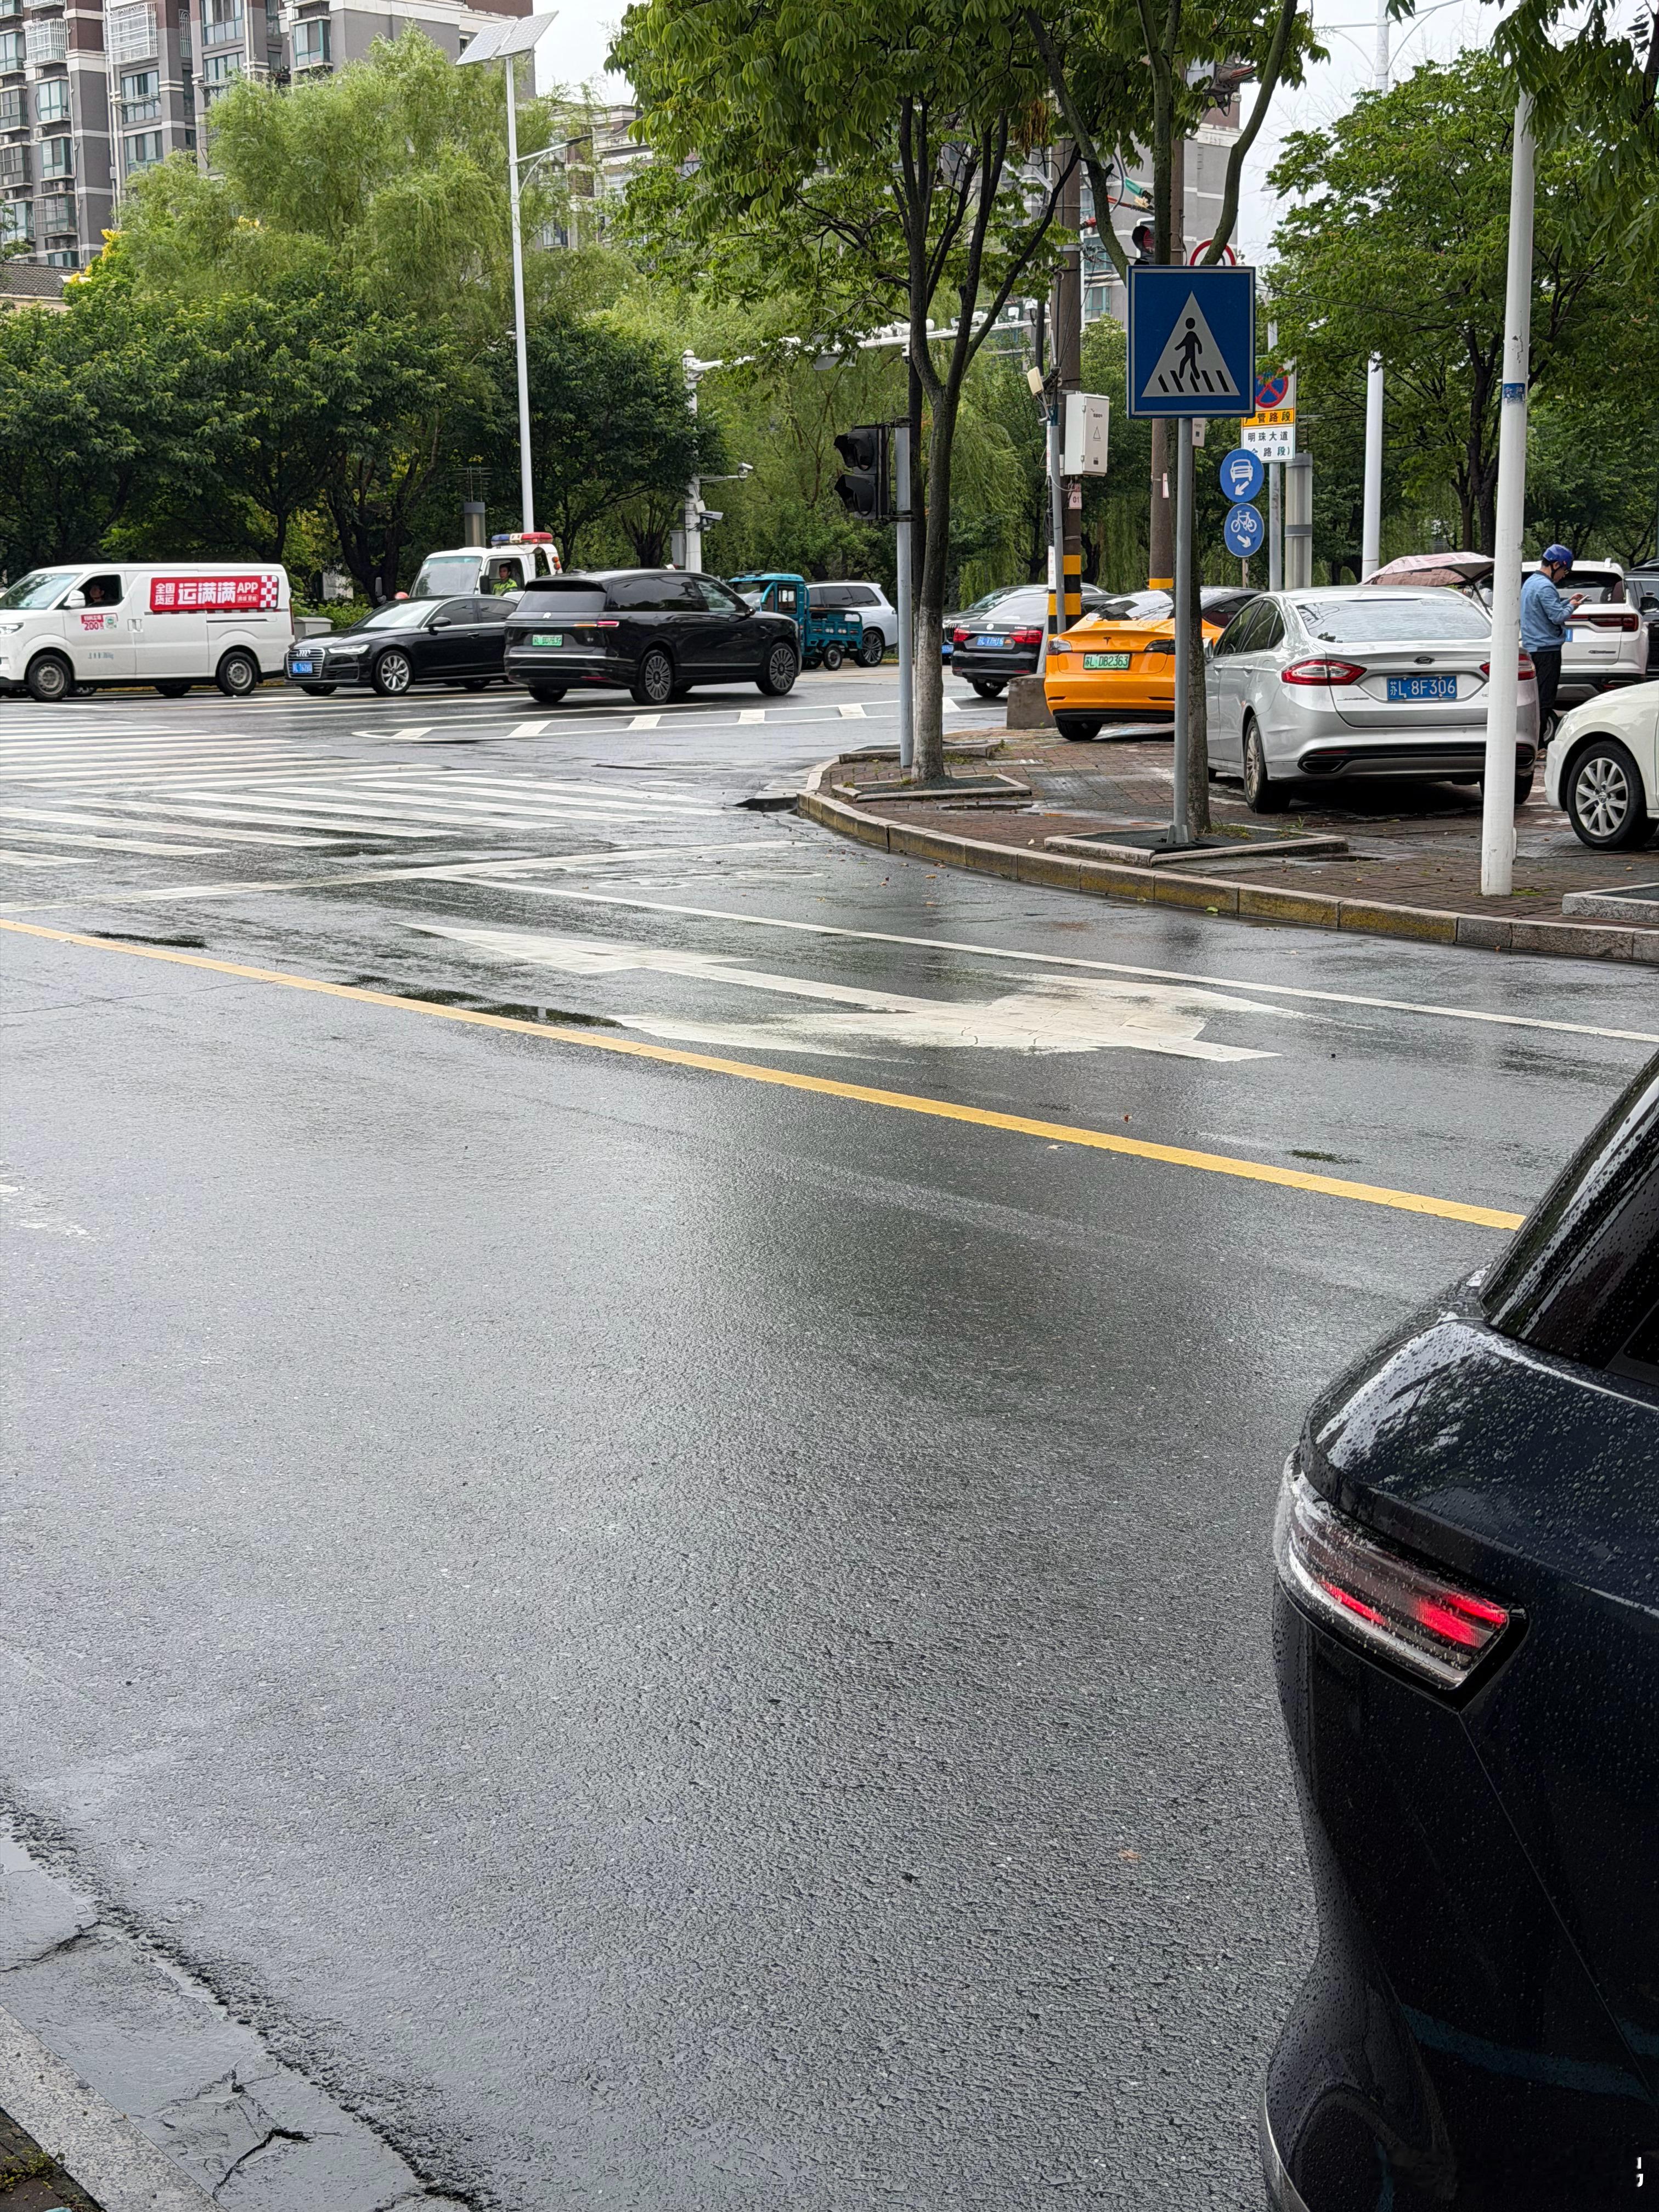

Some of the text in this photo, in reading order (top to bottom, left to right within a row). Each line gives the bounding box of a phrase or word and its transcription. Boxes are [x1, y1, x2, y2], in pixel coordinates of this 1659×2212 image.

[1245, 411, 1291, 424] 管路段
[1248, 431, 1288, 442] 明珠大道
[155, 583, 175, 594] 全国
[177, 582, 258, 605] 运满满 APP
[155, 594, 175, 606] 货运
